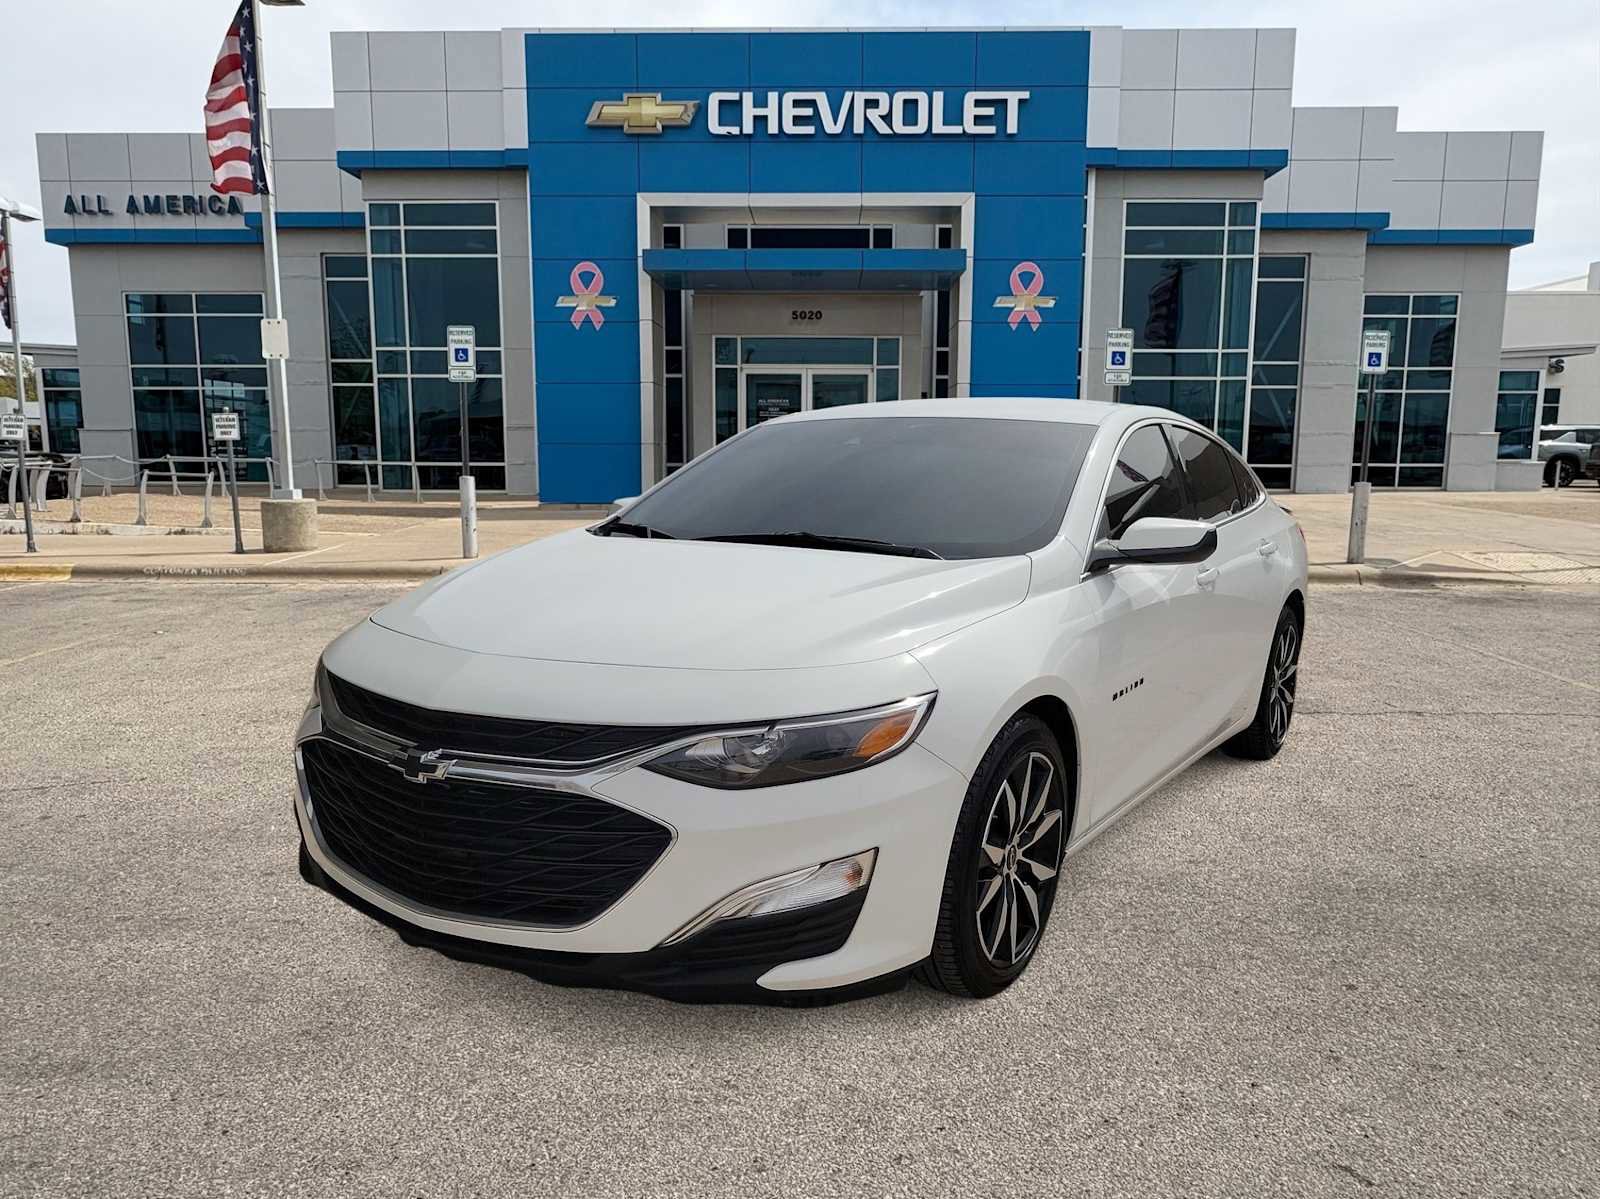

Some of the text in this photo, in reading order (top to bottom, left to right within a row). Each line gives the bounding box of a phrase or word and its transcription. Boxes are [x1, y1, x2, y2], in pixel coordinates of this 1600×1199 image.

[707, 90, 1031, 136] CHEVROLET
[64, 195, 243, 217] ALL AMERICA
[791, 310, 823, 321] 5020
